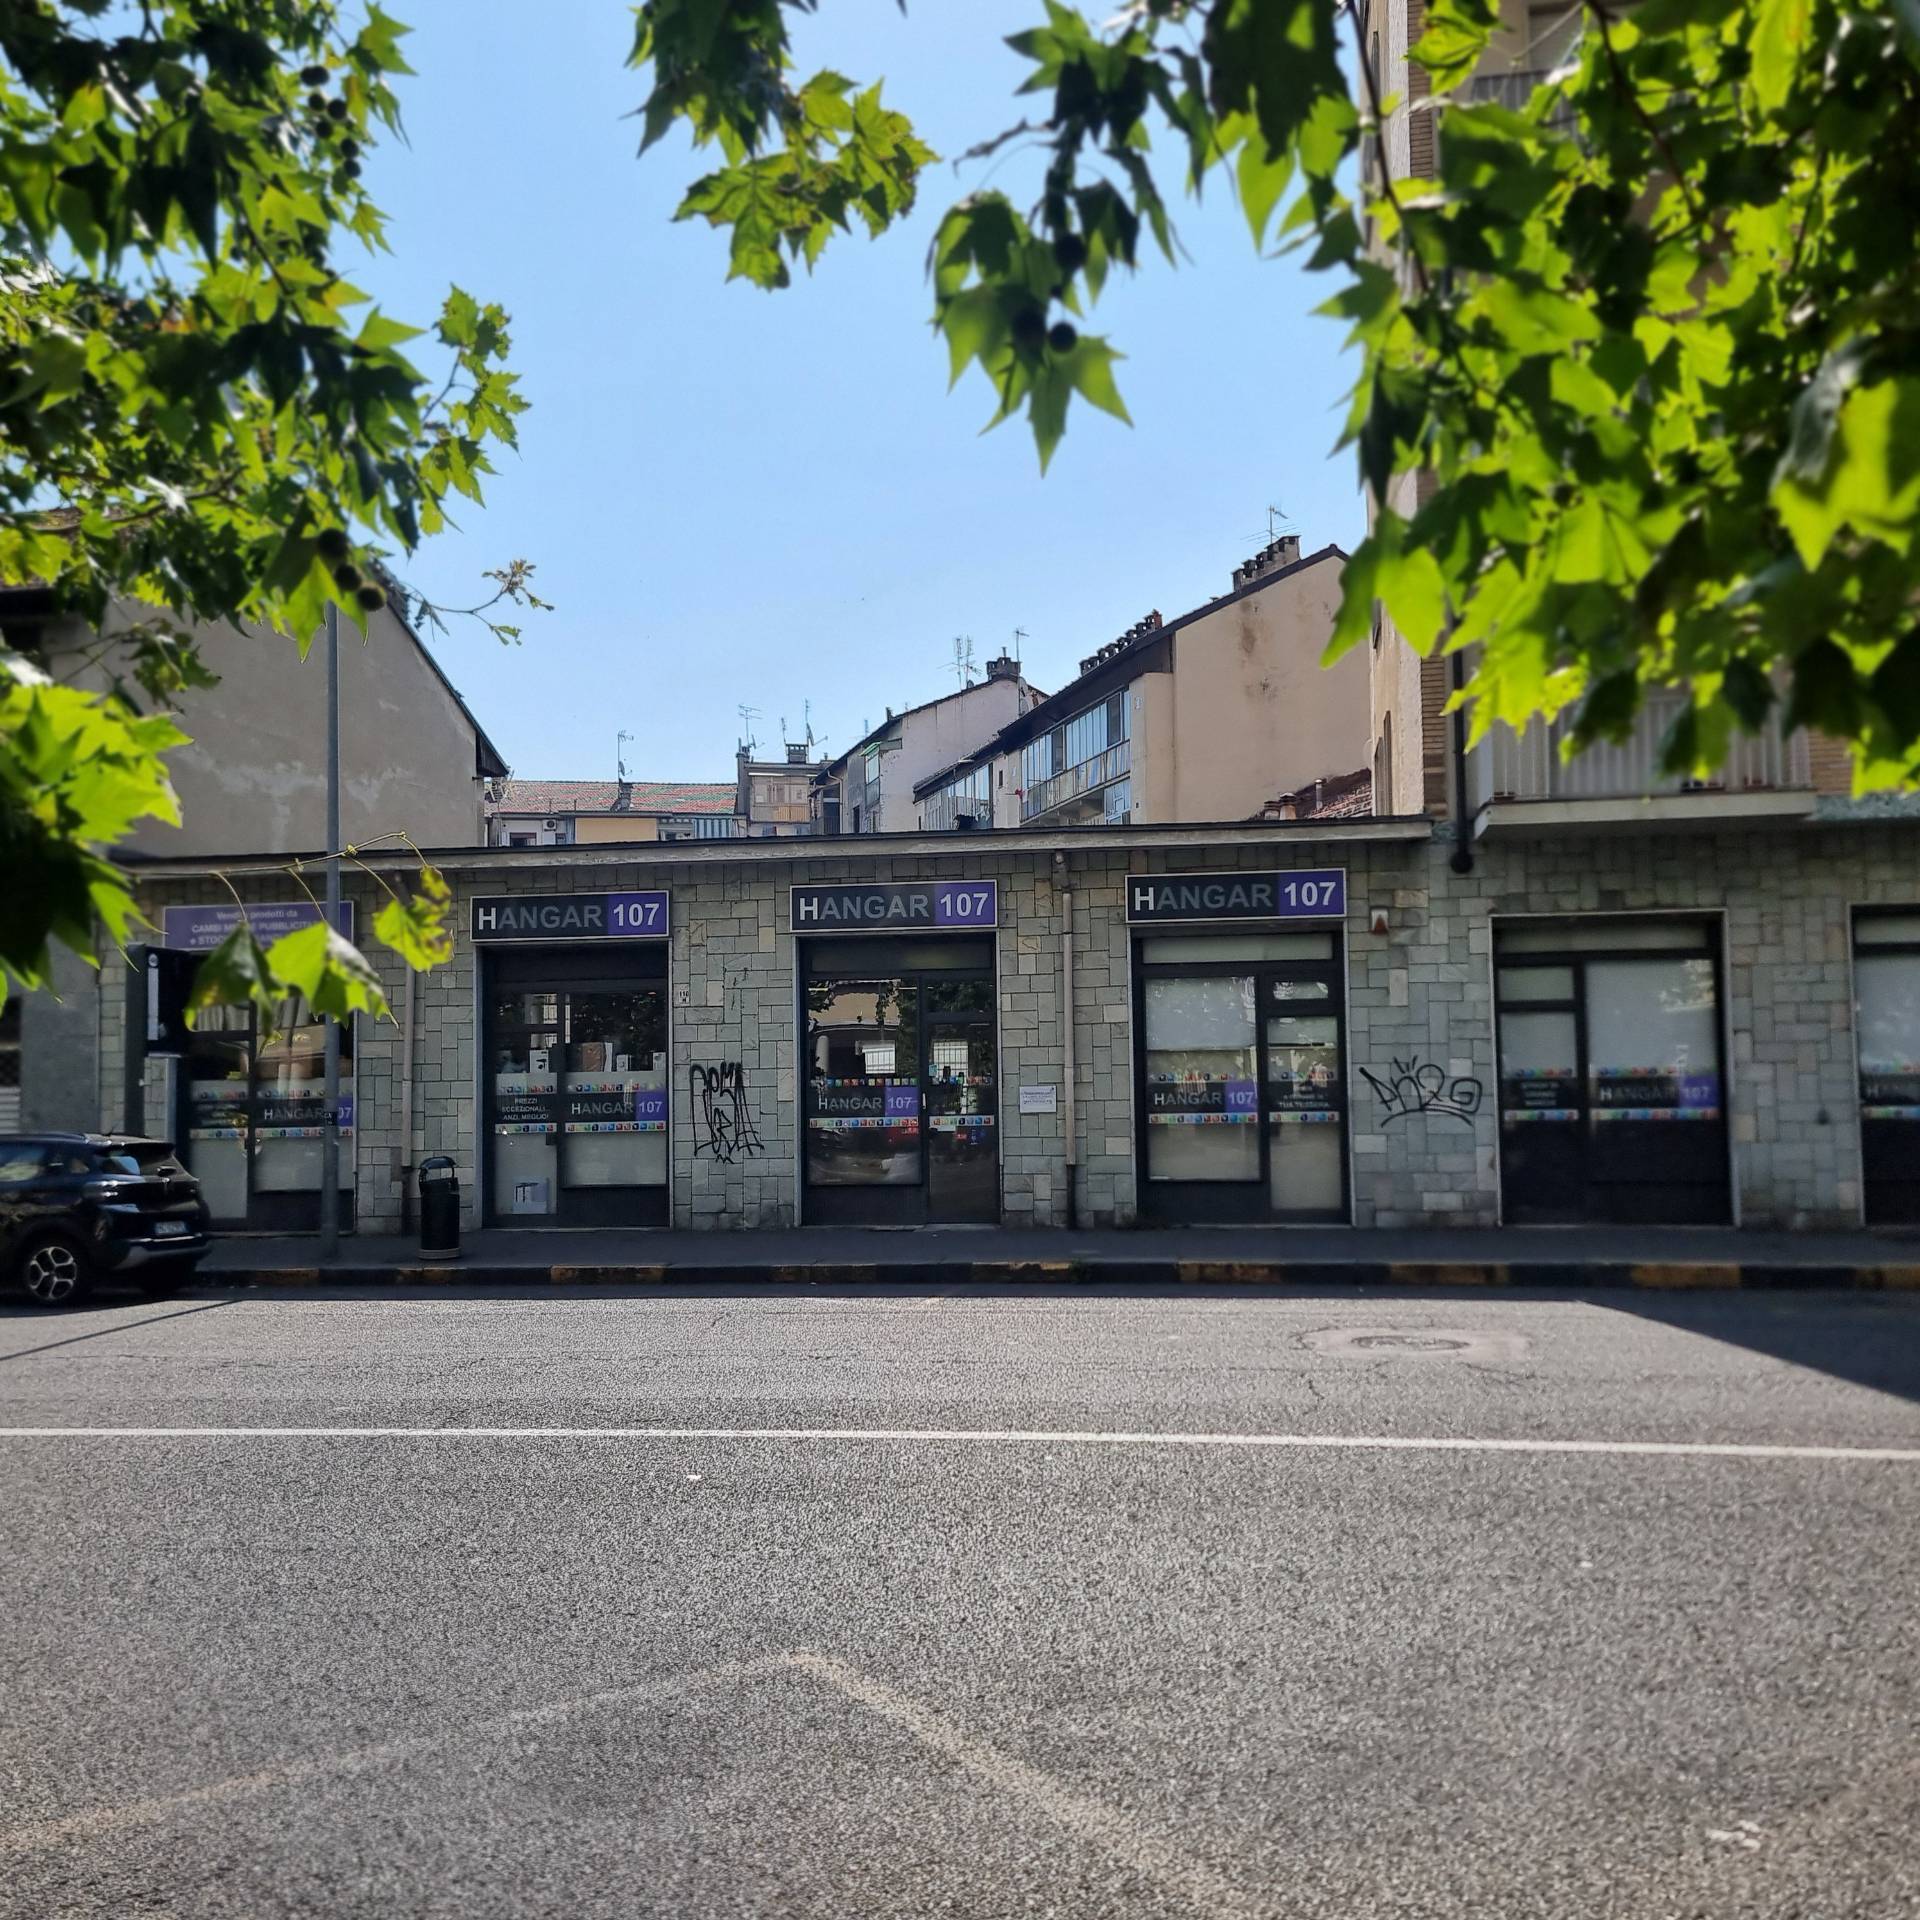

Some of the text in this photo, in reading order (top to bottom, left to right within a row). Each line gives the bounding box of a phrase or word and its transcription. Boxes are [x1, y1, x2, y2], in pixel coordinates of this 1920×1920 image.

[1134, 881, 1336, 911] HANGAR 107
[799, 892, 988, 920] HANGAR 107
[478, 903, 660, 930] HANGAR 107
[818, 1096, 912, 1110] HANGAR 107
[1154, 1091, 1254, 1105] HANGAR 107
[264, 1107, 325, 1119] HANGAR
[571, 1101, 662, 1115] HANGAR 107
